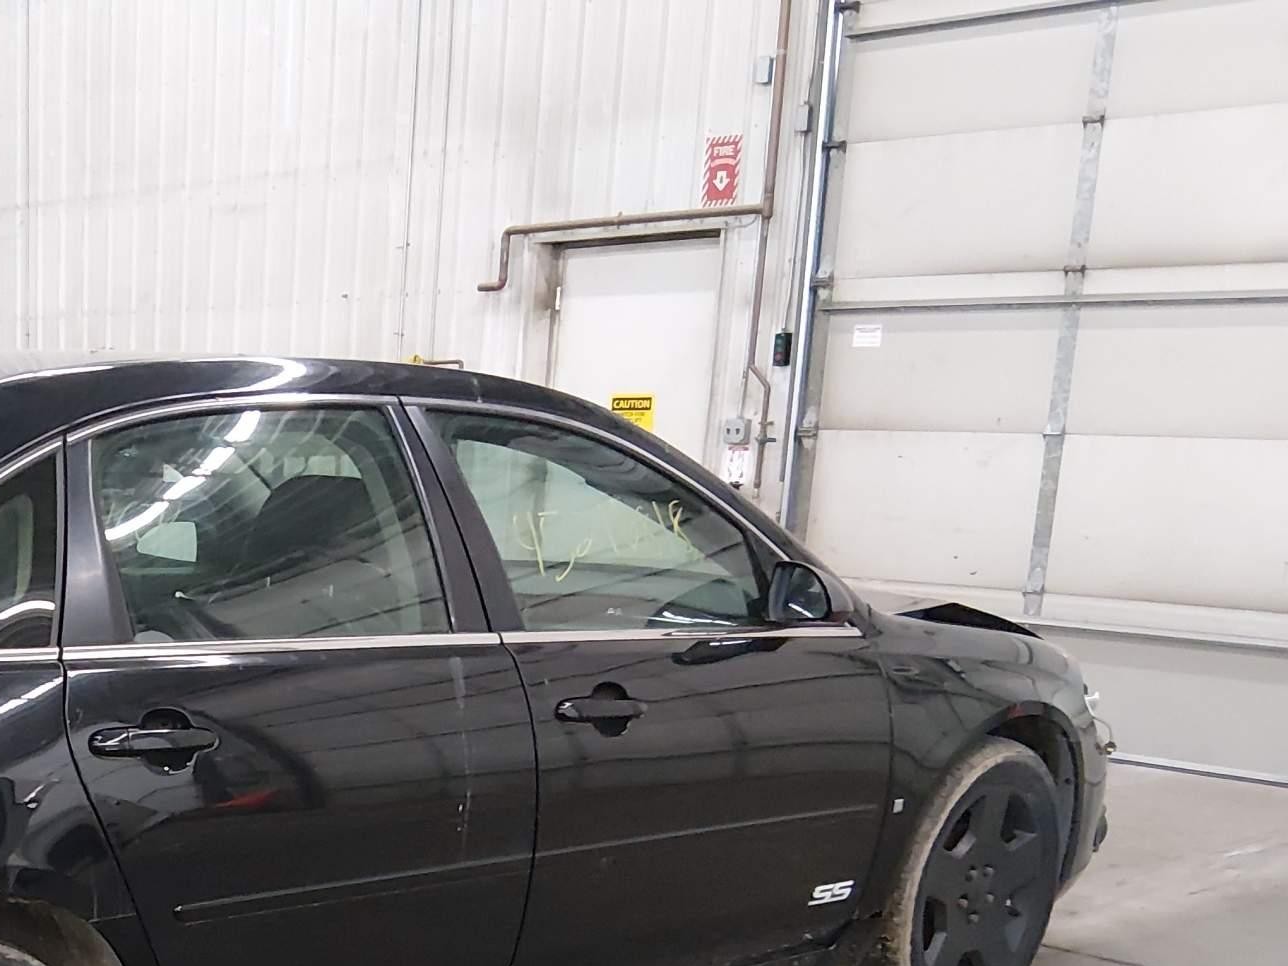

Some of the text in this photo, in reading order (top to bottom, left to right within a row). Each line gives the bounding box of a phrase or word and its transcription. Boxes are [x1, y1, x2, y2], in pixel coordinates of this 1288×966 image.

[713, 145, 736, 157] FIRE
[613, 399, 651, 409] CAUTION
[807, 880, 855, 906] SS
